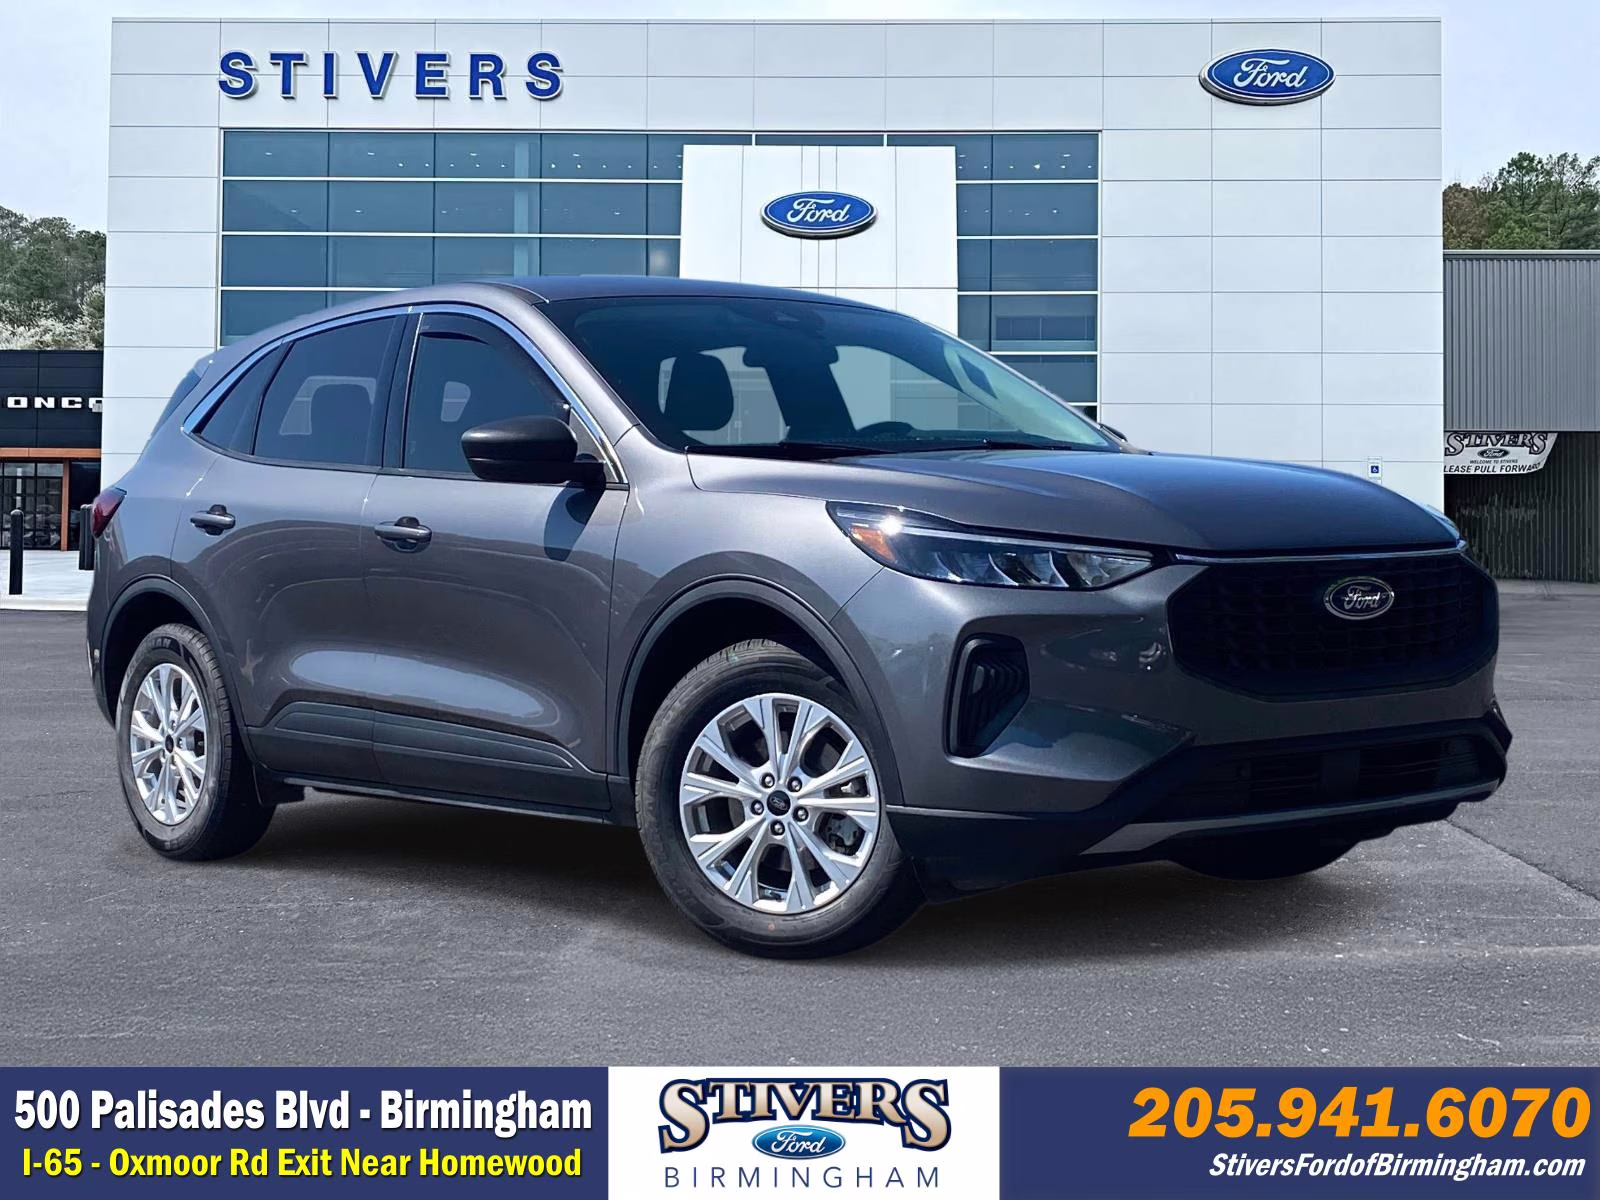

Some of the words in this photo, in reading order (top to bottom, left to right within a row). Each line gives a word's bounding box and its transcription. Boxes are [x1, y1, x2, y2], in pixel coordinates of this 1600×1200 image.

[218, 51, 563, 100] STIVERS
[1233, 58, 1308, 88] Ford
[786, 198, 851, 223] Ford
[1444, 431, 1548, 456] STIVERS
[1474, 465, 1497, 473] PULL
[1343, 585, 1381, 610] Ford
